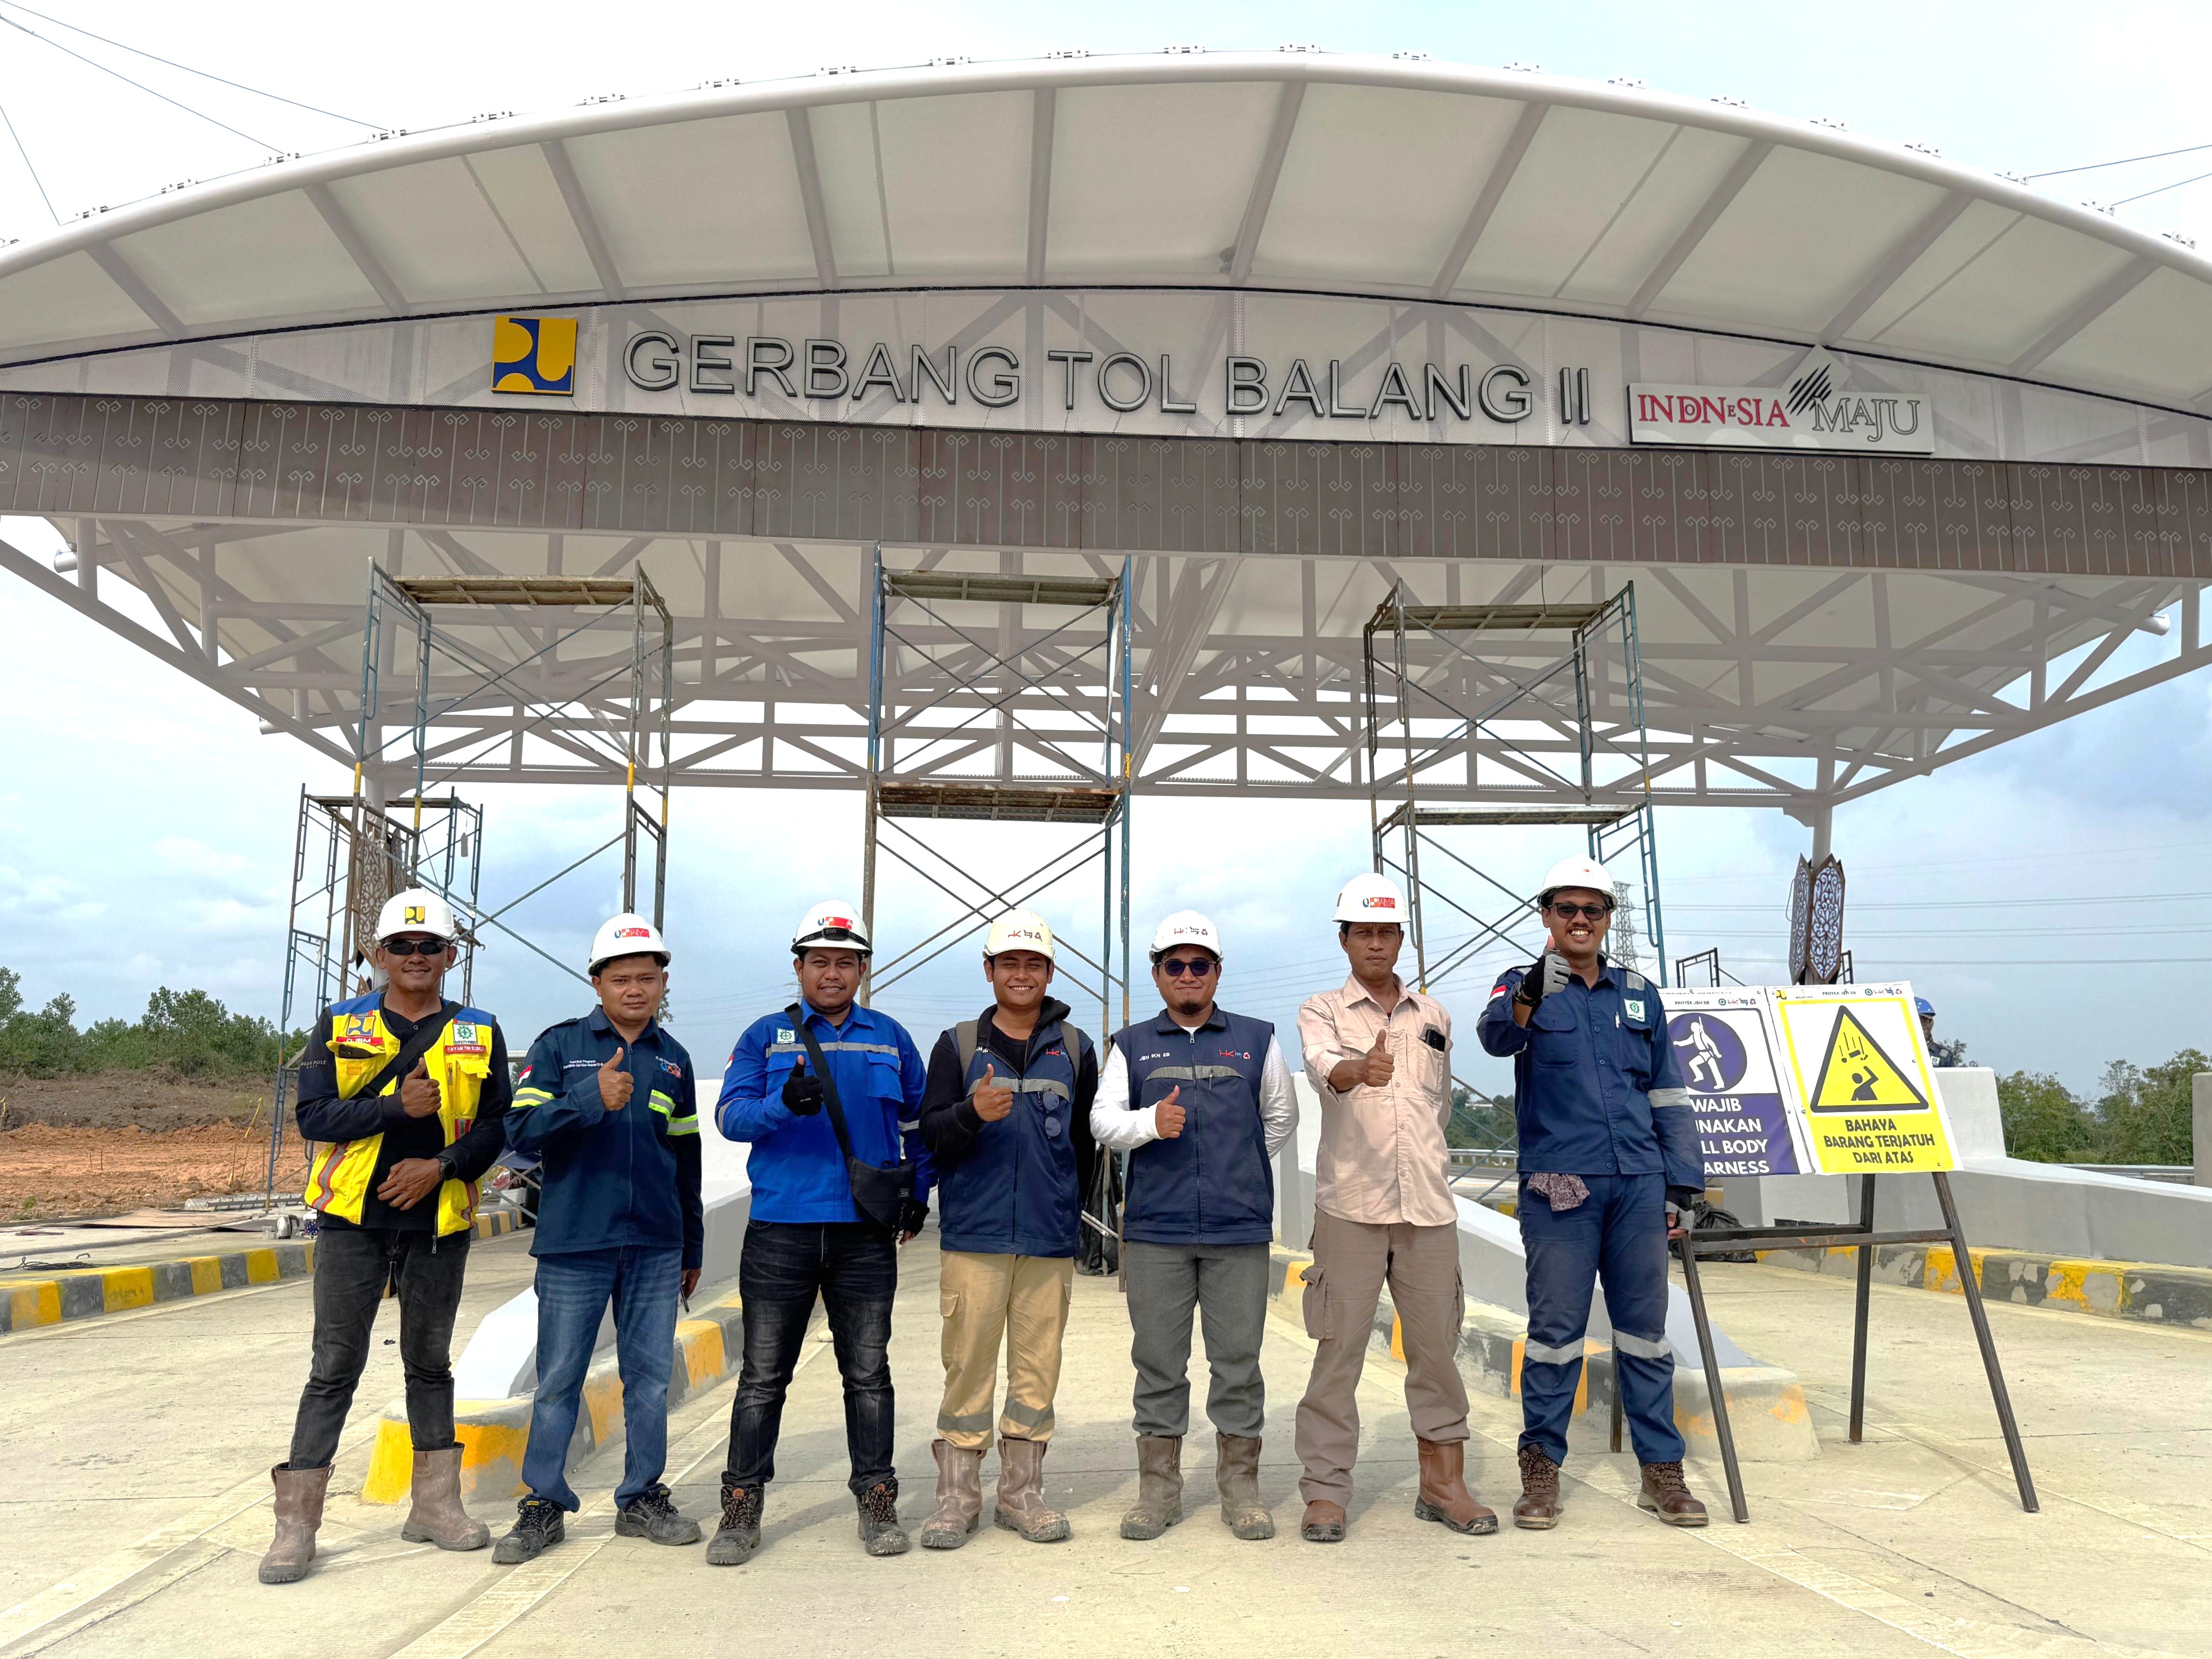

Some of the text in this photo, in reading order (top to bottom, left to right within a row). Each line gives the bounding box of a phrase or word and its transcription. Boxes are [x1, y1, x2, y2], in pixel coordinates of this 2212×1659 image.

[623, 330, 1590, 425] GERBANG TOL BALANG II
[1812, 397, 1920, 442] MAJU
[1690, 1098, 1742, 1112] WAJIB
[1695, 1118, 1762, 1133] NAKAN
[1845, 1118, 1897, 1132] BAHAYA
[1701, 1139, 1768, 1154] LL BODY
[1823, 1134, 1936, 1148] BARANG TERJATUH
[1852, 1151, 1914, 1164] DARI ATAS
[1704, 1160, 1770, 1174] ARNESS
